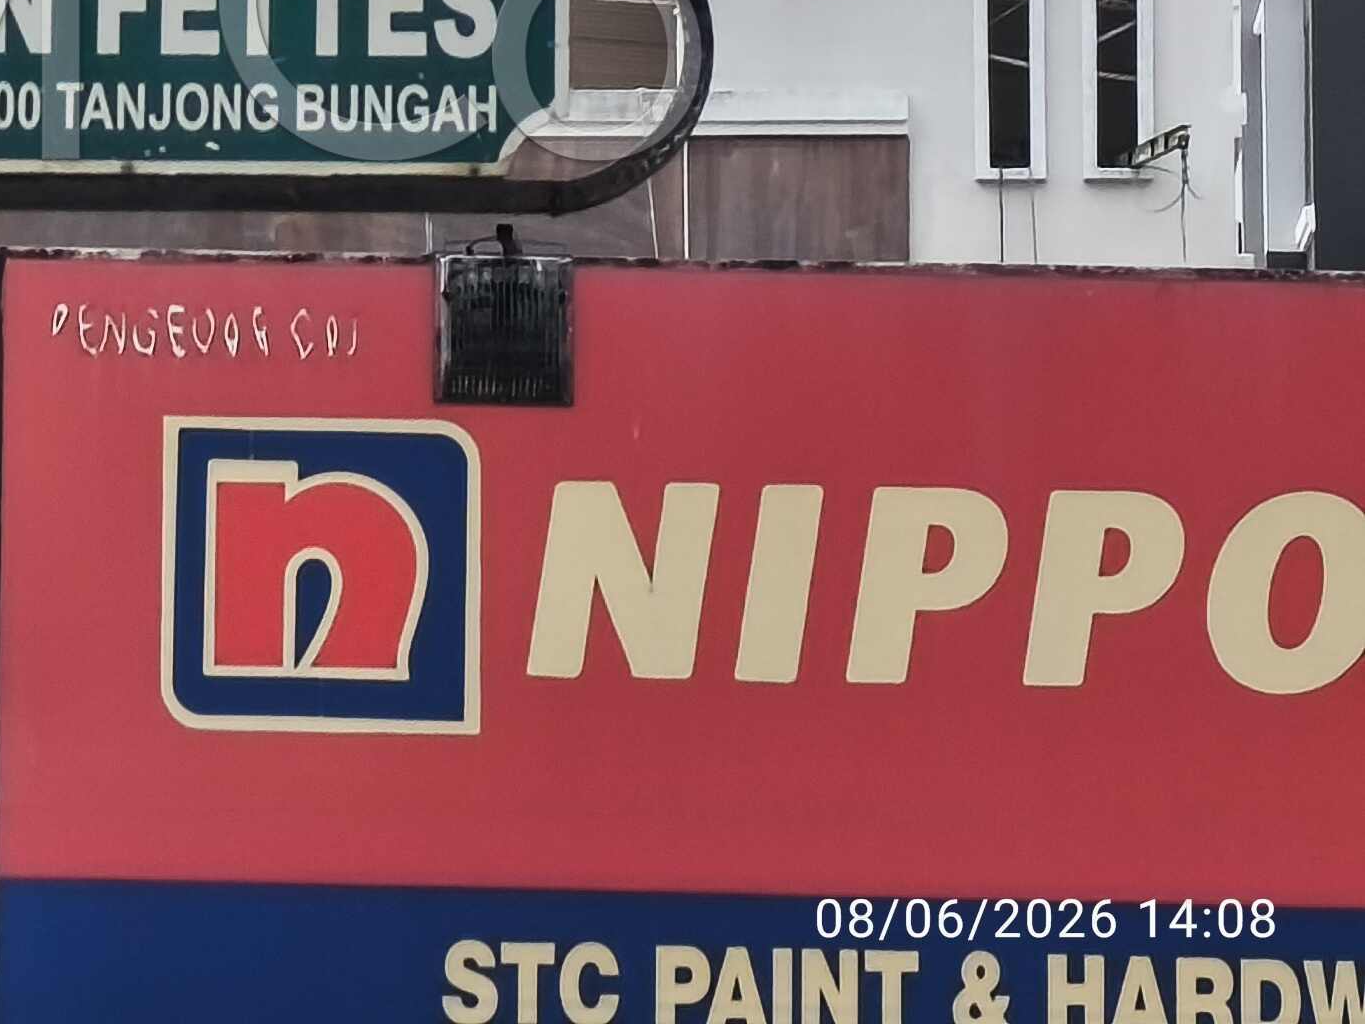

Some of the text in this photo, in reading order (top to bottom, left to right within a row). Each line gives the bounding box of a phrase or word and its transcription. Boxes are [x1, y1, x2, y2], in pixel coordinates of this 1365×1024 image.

[56, 81, 279, 131] TANJONG
[295, 82, 497, 132] BUNGAH
[527, 480, 1365, 694] NIPPO
[442, 939, 620, 1024] STC
[655, 944, 920, 1024] PAINT
[952, 950, 1010, 1024] &
